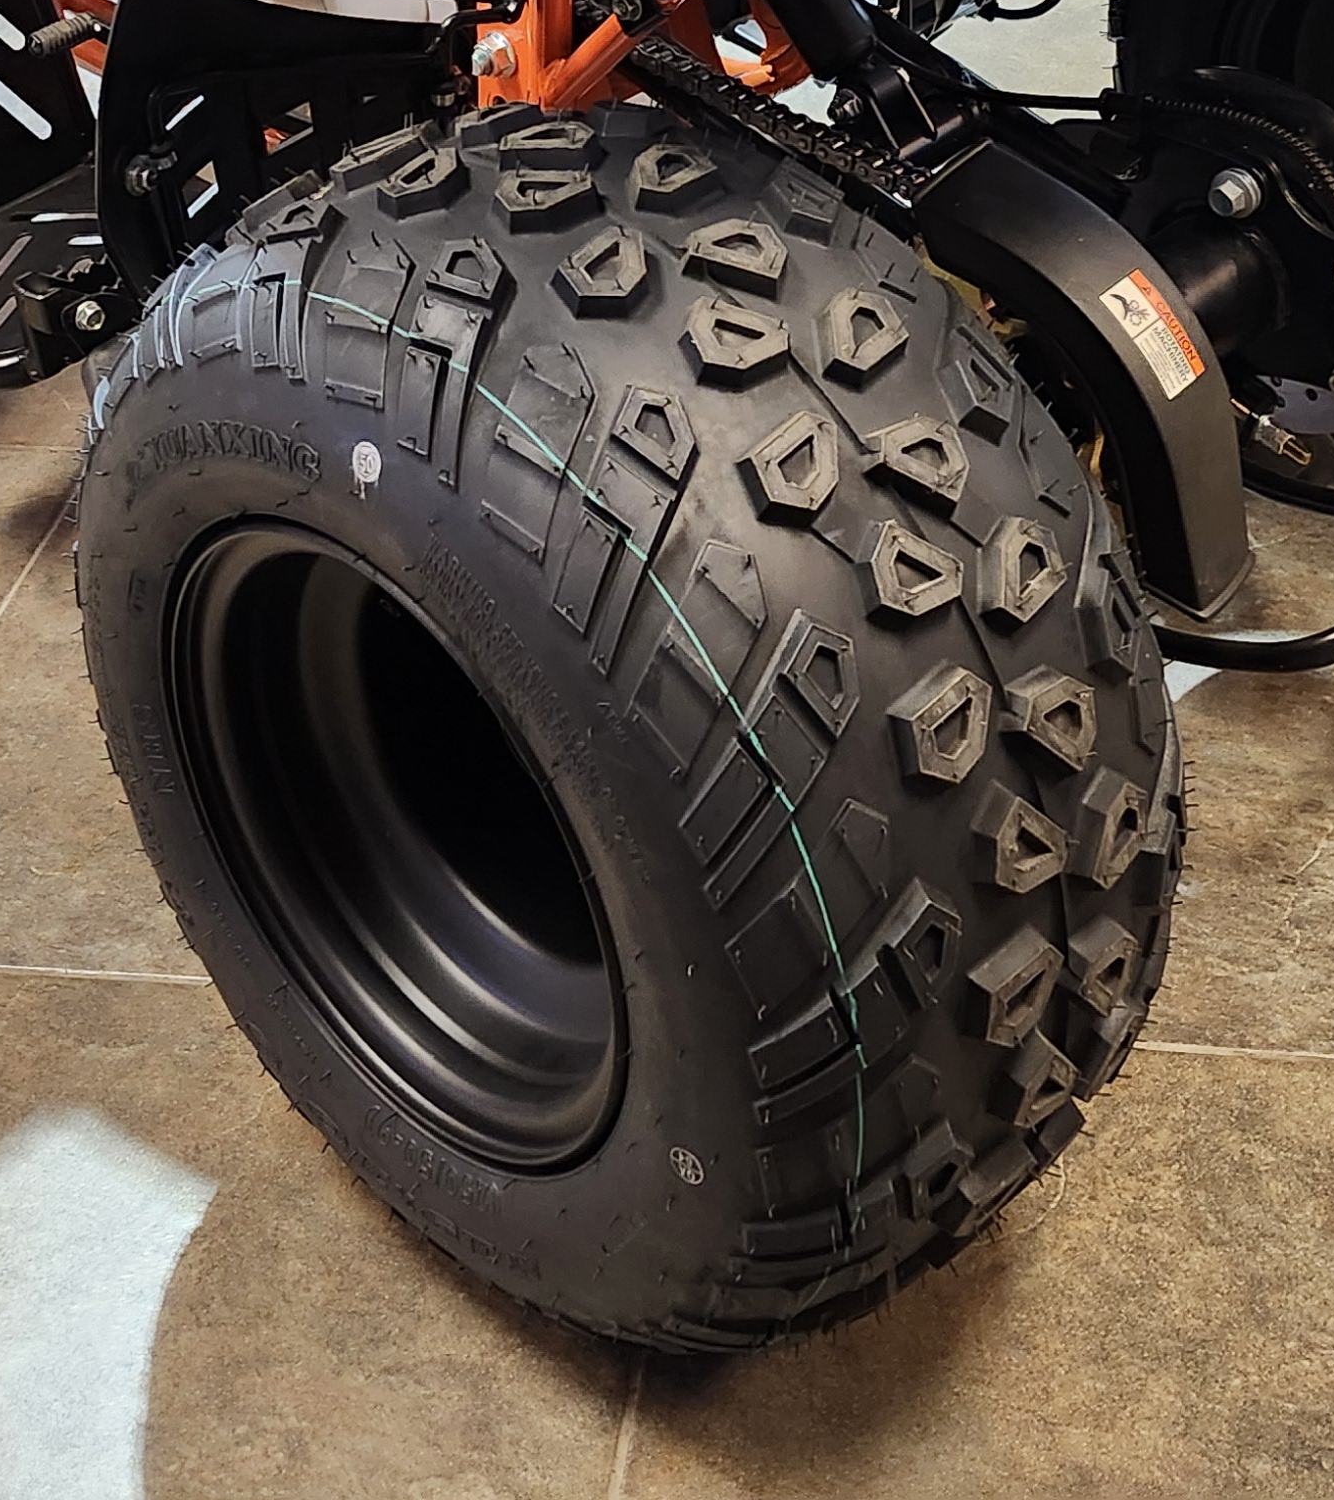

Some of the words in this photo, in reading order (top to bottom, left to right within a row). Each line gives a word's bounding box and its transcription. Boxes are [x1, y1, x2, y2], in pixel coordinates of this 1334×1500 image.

[1153, 327, 1189, 383] MACHINERY
[1156, 301, 1197, 361] CAUTION
[1160, 327, 1191, 375] ROTATING
[144, 418, 322, 484] YUANXING
